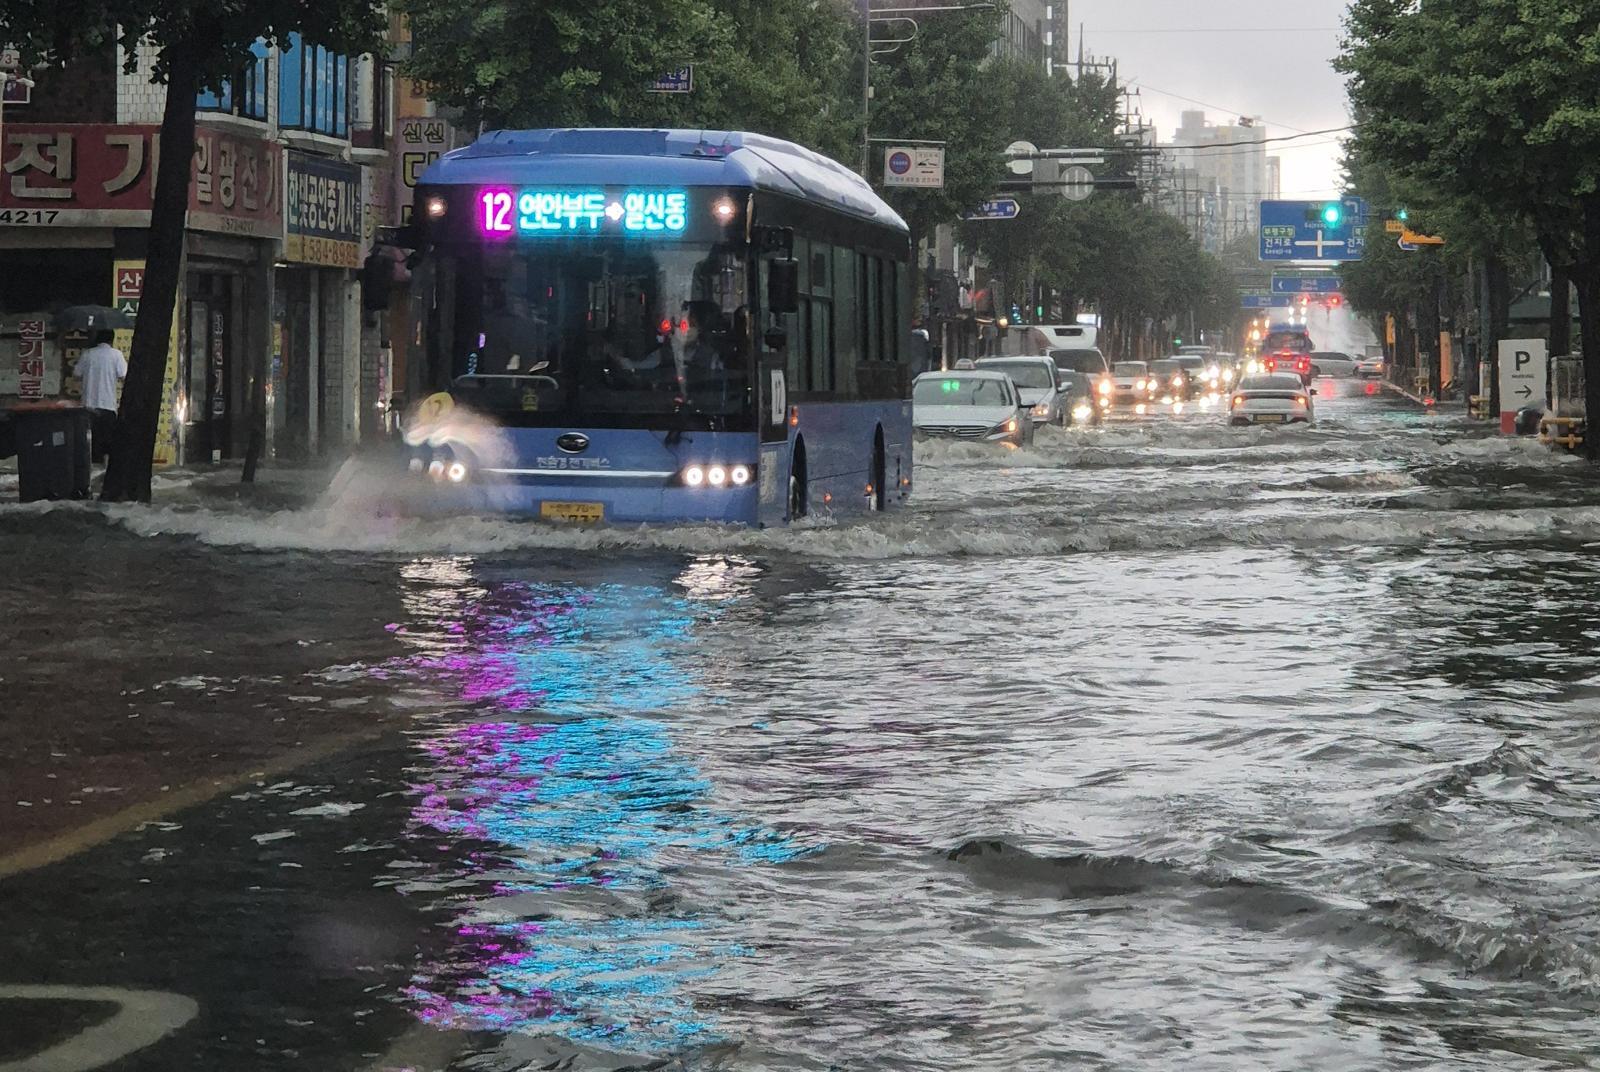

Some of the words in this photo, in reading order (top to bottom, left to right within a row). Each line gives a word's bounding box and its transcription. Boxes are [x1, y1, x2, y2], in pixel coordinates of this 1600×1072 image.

[403, 123, 444, 143] 신신
[3, 133, 161, 200] 전기
[194, 137, 279, 214] 일광전기
[0, 210, 59, 224] 4217
[483, 192, 511, 230] 12
[519, 192, 605, 229] 연안부두
[624, 192, 685, 230] 일신동
[1265, 238, 1292, 248] 건지로
[18, 320, 45, 399] 전기재료
[1515, 351, 1530, 371] P
